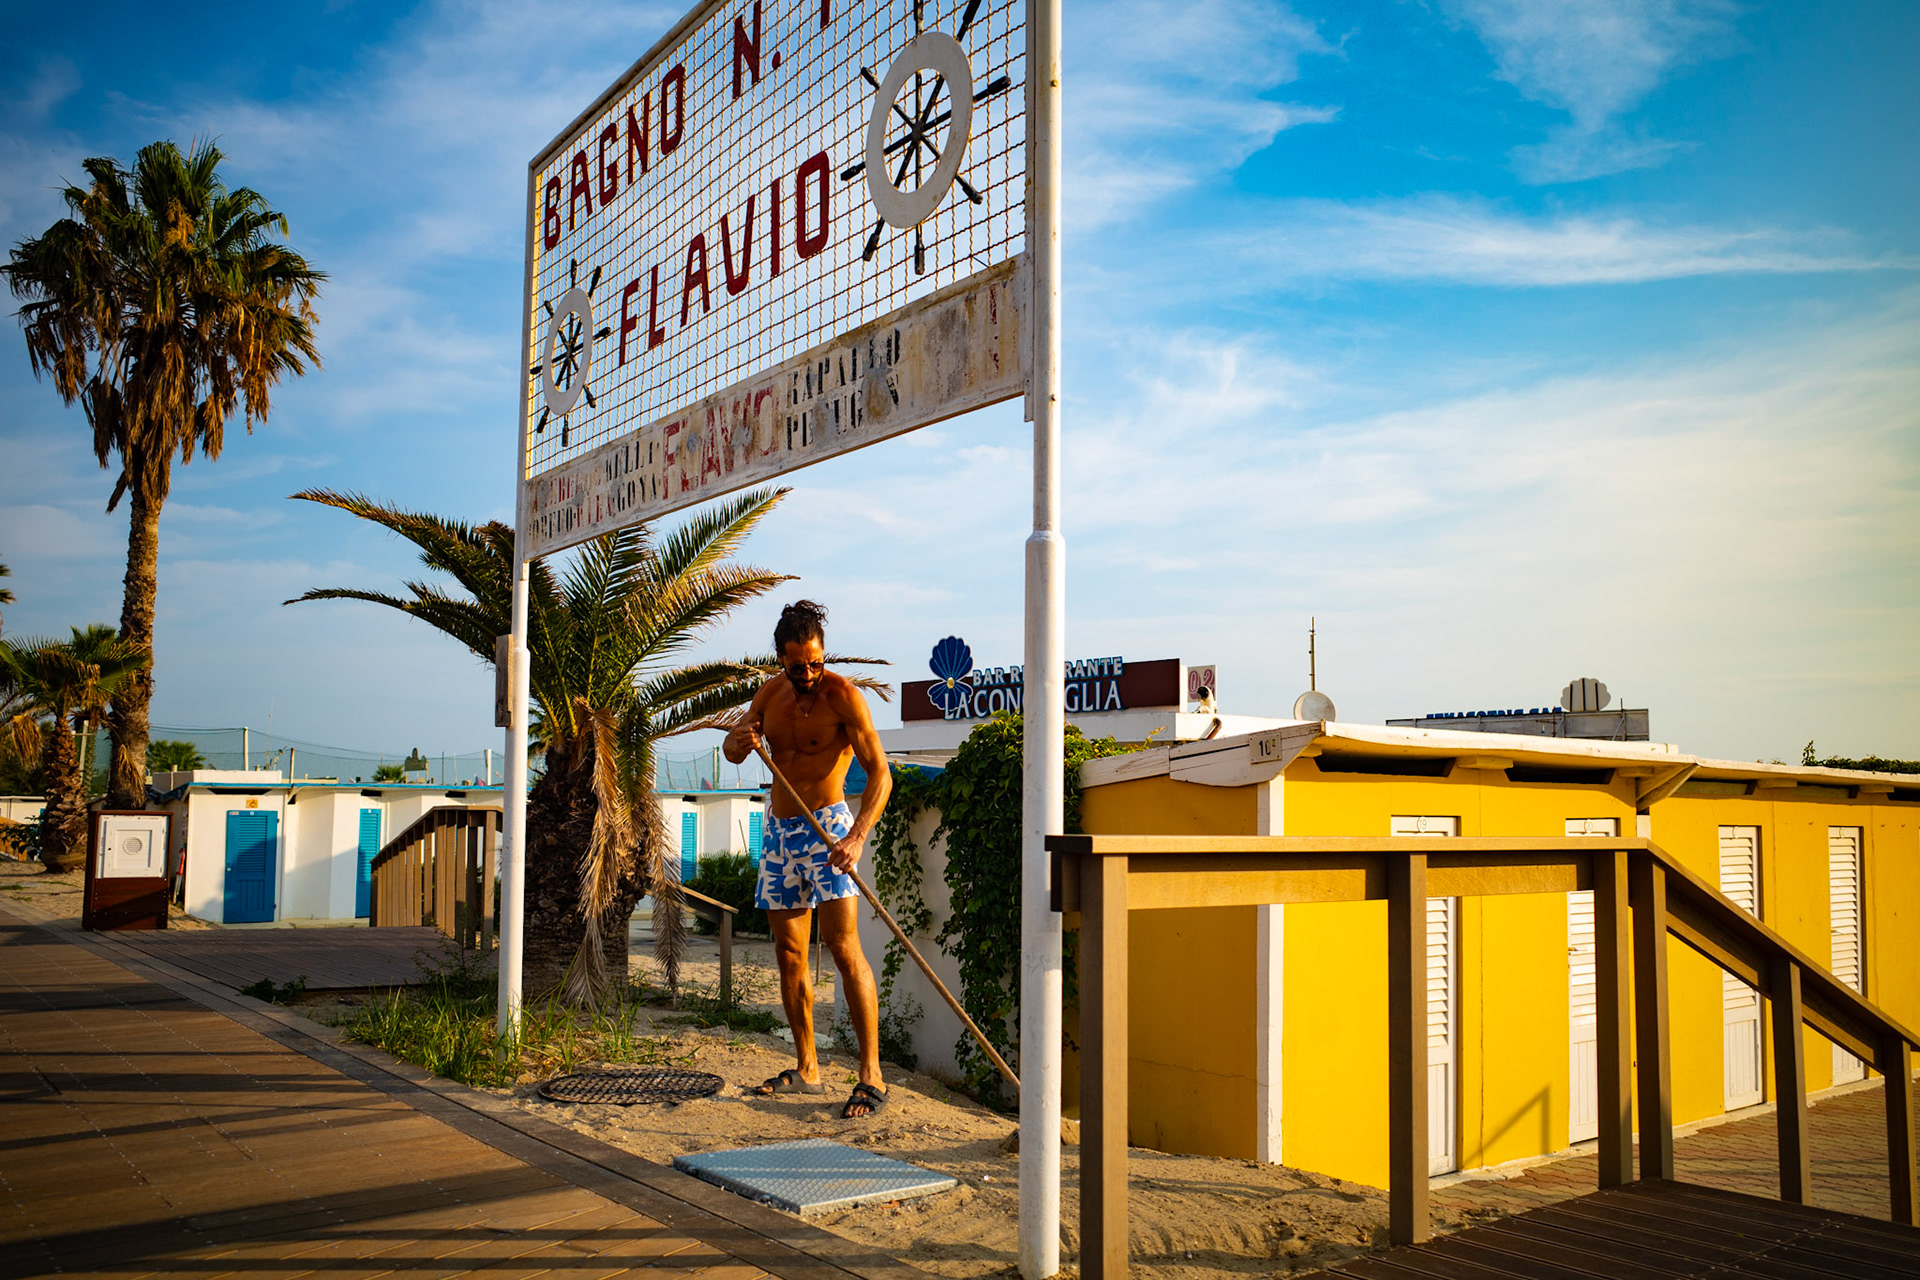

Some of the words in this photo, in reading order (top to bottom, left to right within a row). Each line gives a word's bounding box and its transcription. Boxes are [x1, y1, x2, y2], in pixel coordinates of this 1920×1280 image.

[544, 63, 686, 250] BAGNO
[732, 0, 781, 99] N.
[618, 150, 830, 367] FLAVIO
[972, 667, 1006, 688] BAR
[1009, 656, 1123, 686] RRANTE
[973, 679, 1122, 718] CONGLIA
